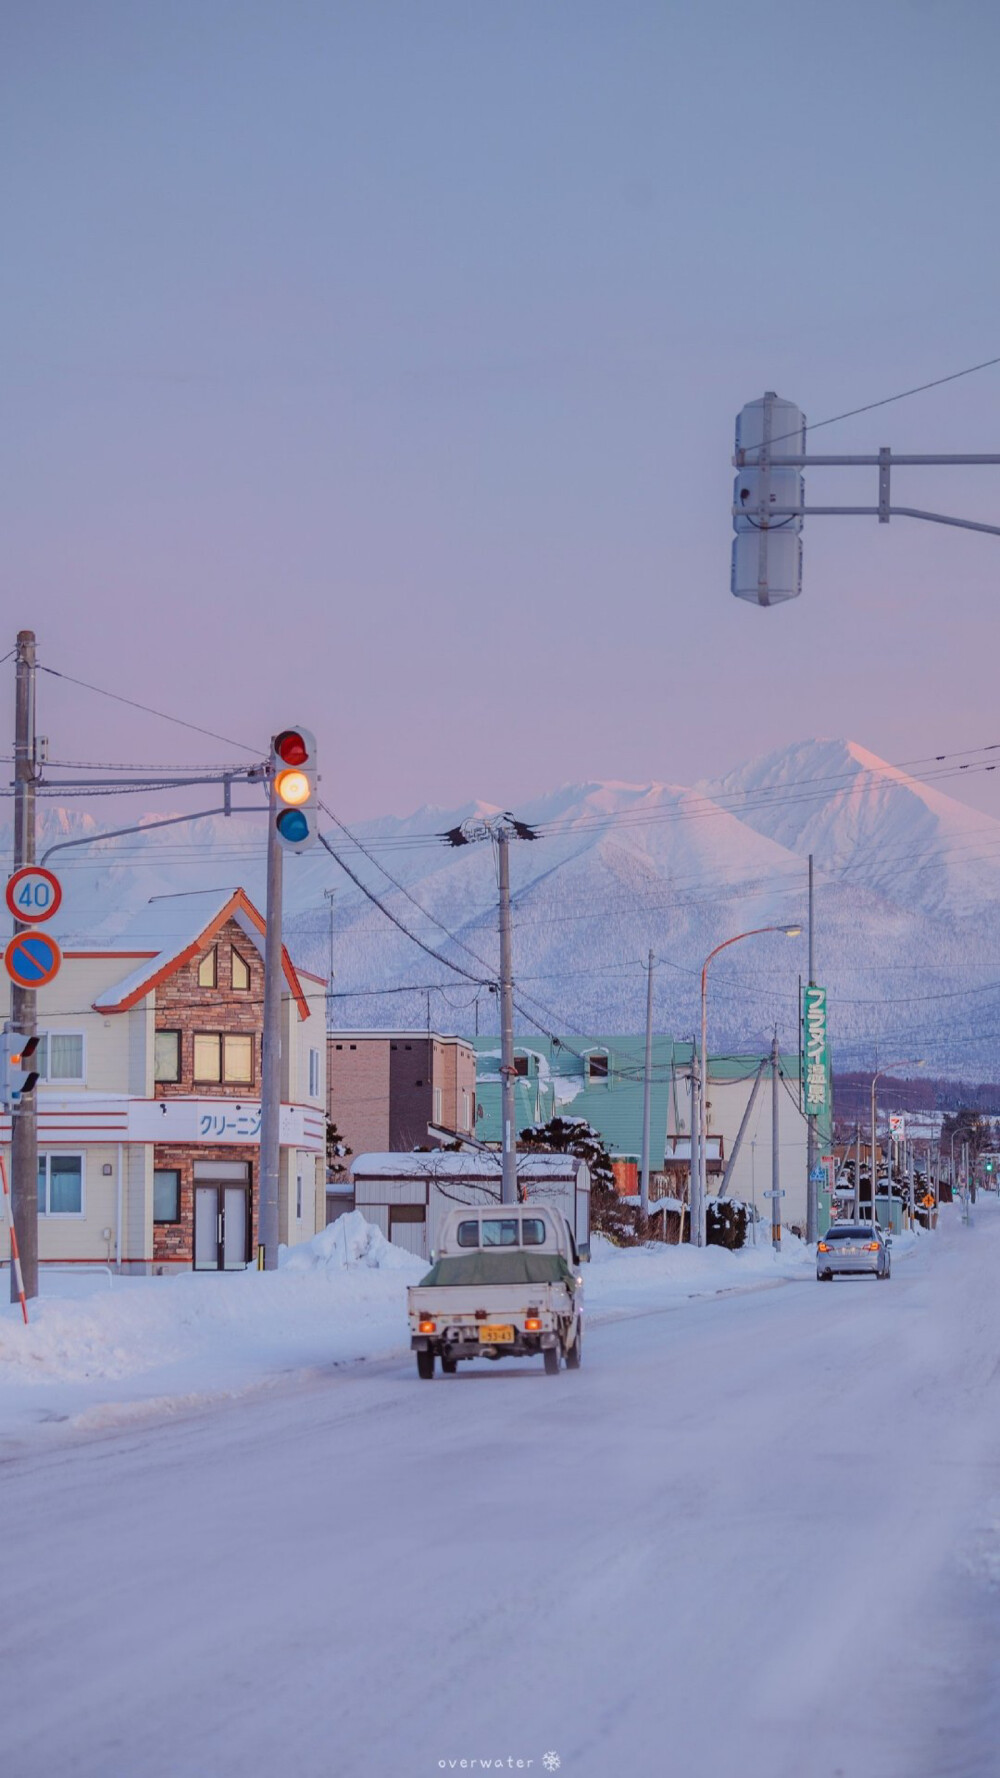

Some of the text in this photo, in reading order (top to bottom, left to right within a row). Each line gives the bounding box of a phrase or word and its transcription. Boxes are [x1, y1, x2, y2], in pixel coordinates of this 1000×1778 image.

[18, 882, 50, 907] 40
[807, 989, 826, 1104] フラヌイ温泉
[200, 1115, 262, 1136] クリーニン
